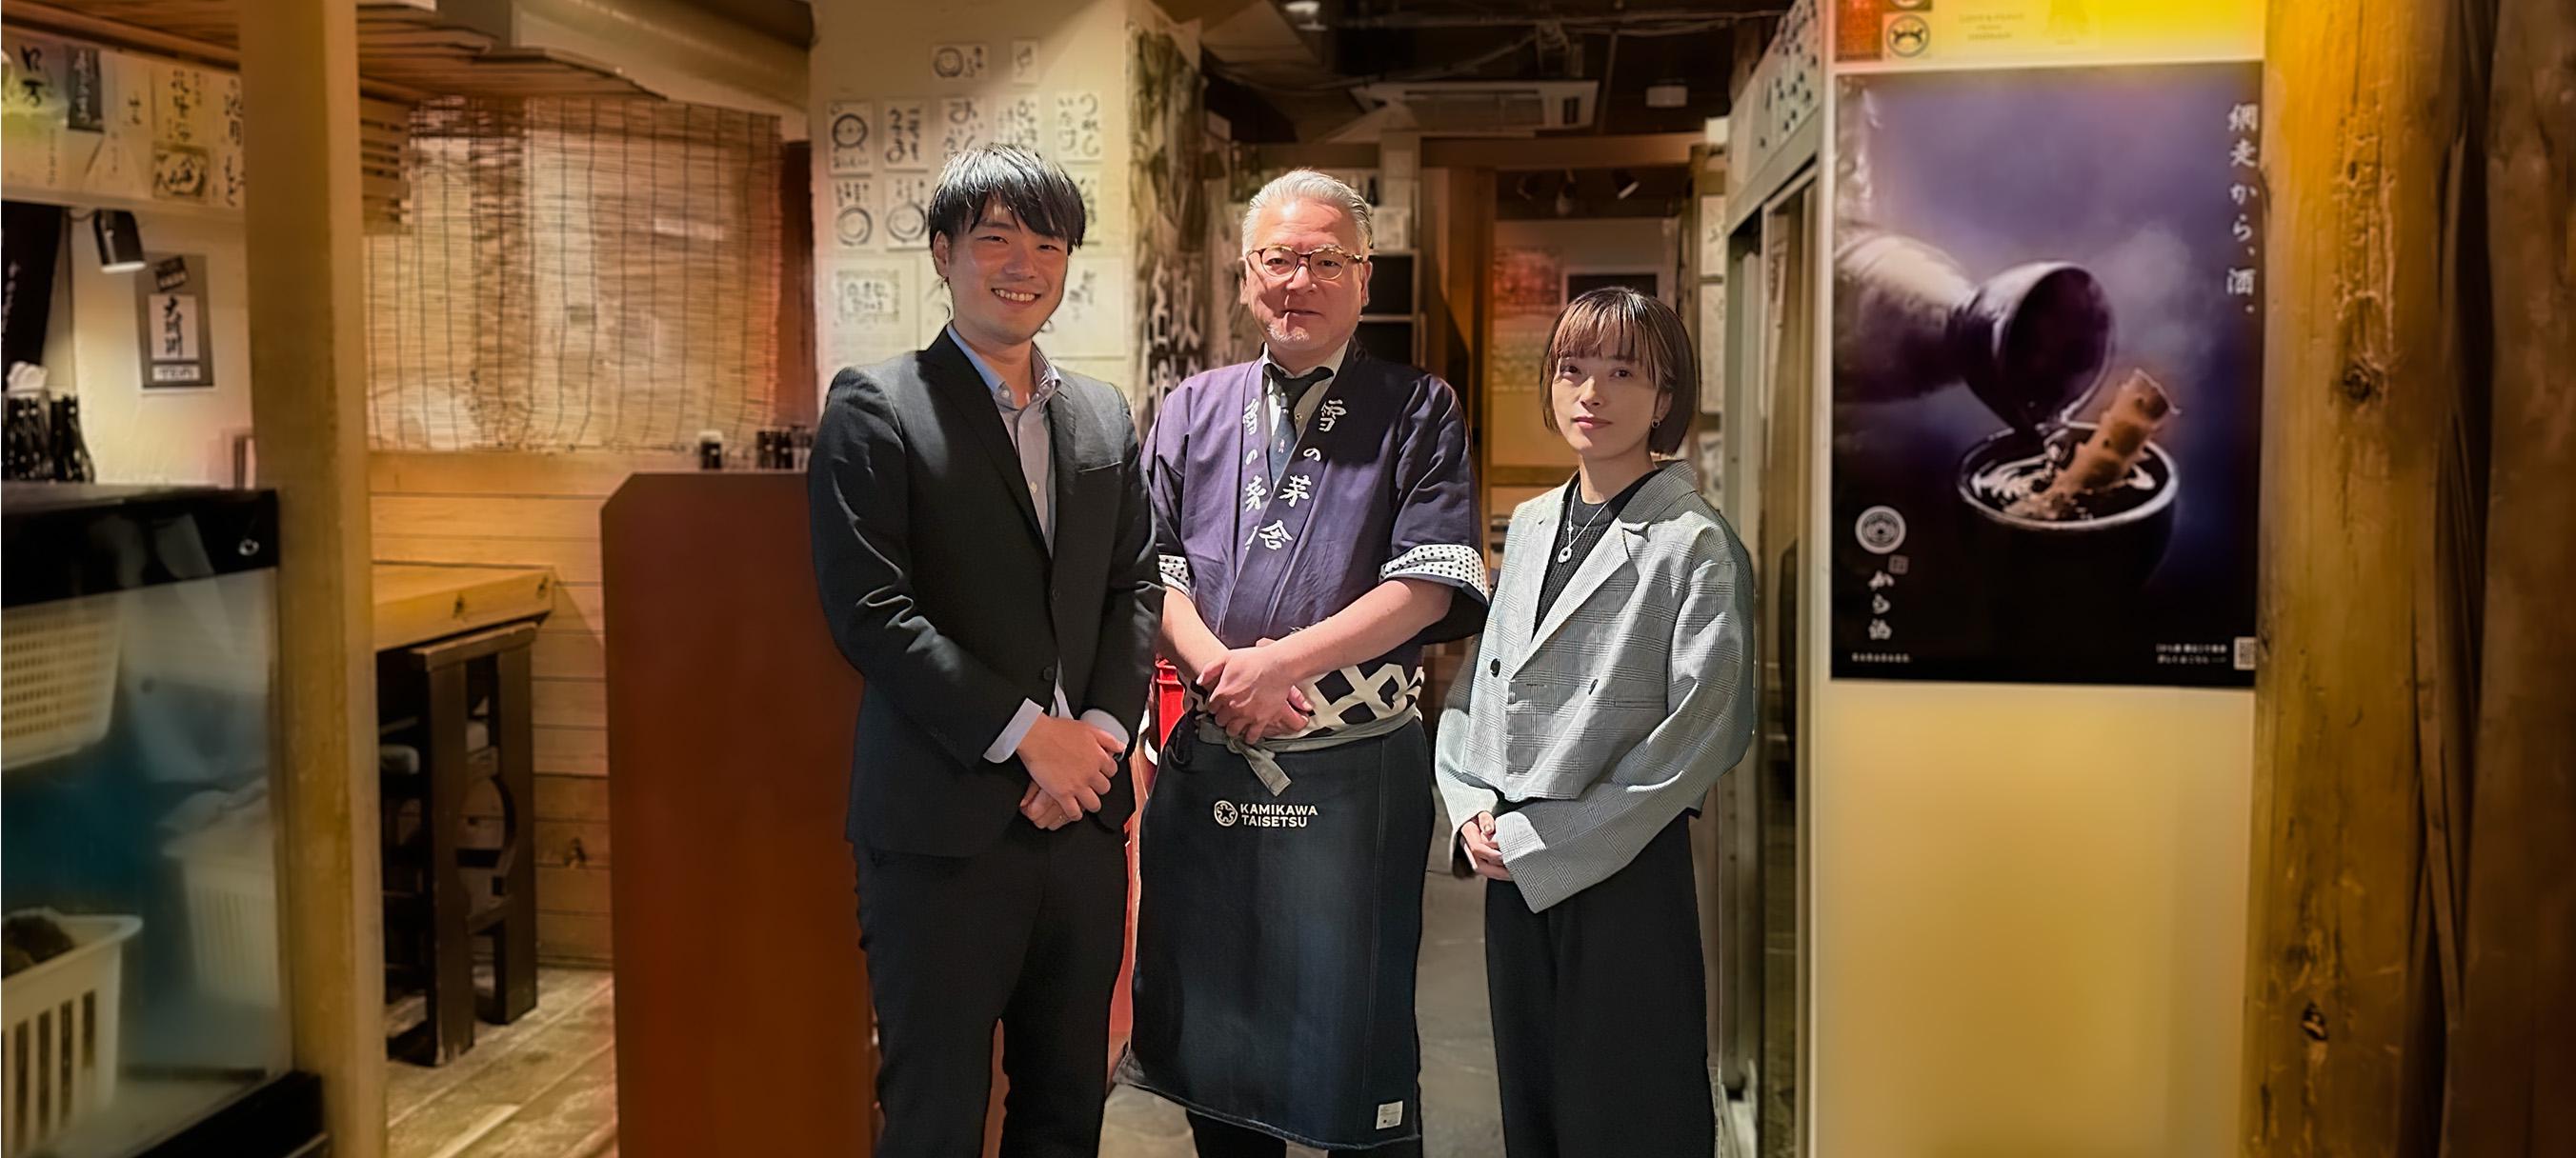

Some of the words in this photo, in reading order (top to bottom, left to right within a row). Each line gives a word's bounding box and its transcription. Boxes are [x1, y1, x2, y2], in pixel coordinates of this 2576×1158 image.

[2226, 103, 2260, 313] 網走から、酒。
[1242, 398, 1267, 551] 雪の茅
[1258, 399, 1347, 550] 雪の茅舎
[1240, 803, 1318, 816] KAMIKAWA
[1241, 814, 1308, 828] TAISETSU
